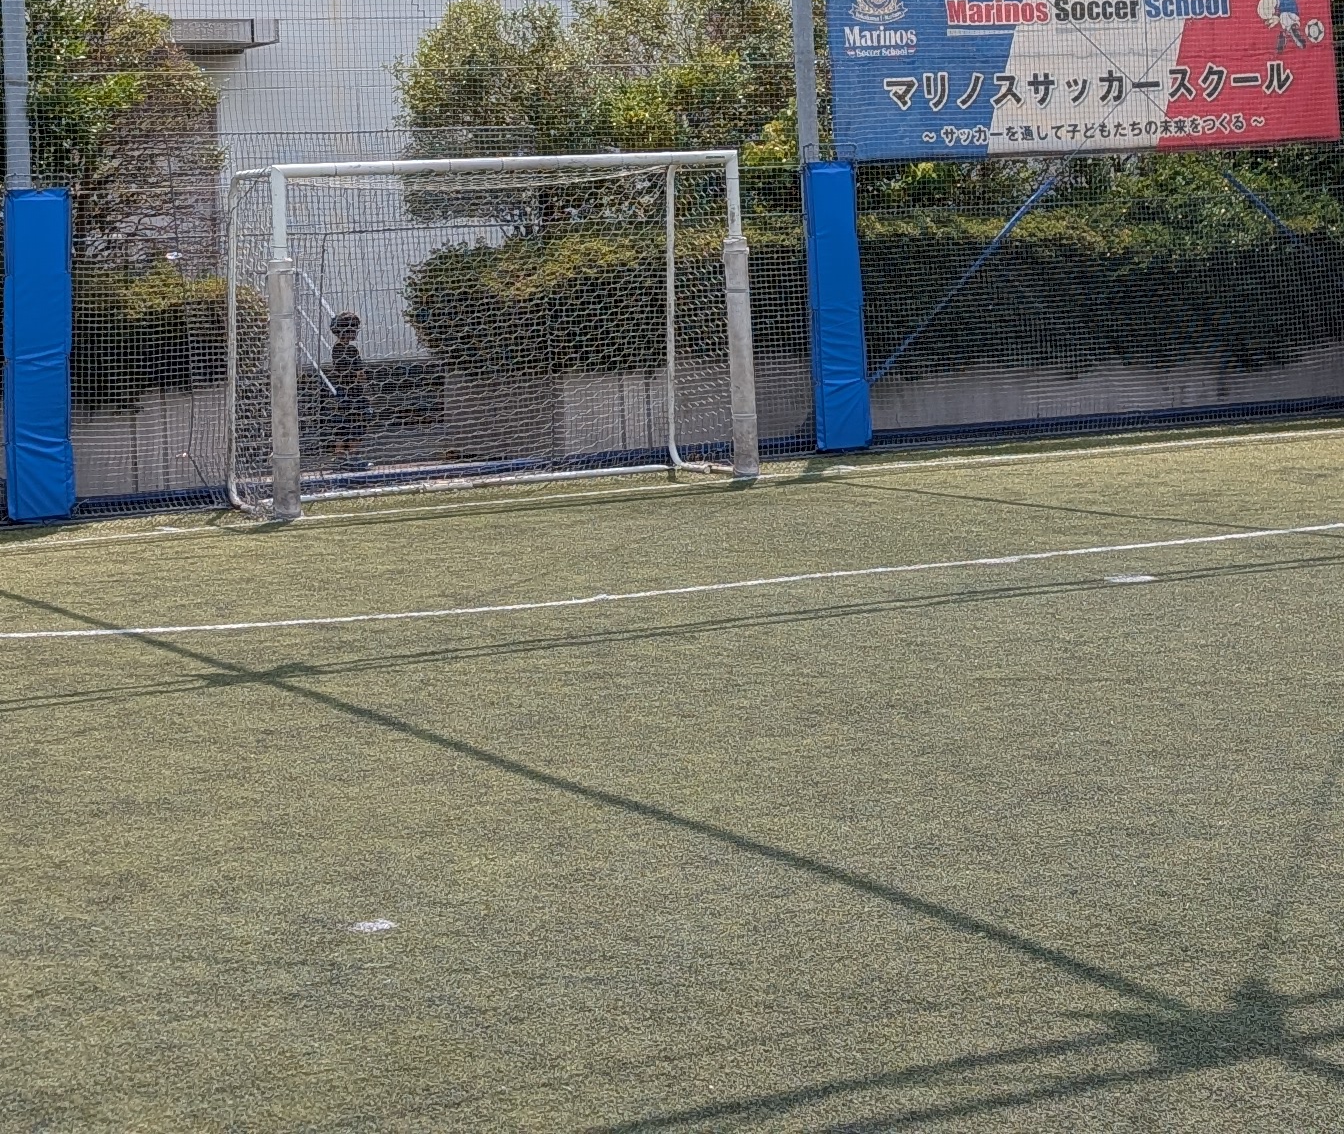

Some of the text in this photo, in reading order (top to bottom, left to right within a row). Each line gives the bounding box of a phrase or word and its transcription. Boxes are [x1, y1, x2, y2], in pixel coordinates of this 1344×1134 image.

[844, 25, 917, 47] Marinos
[884, 62, 1292, 110] マリノスサッカースクール
